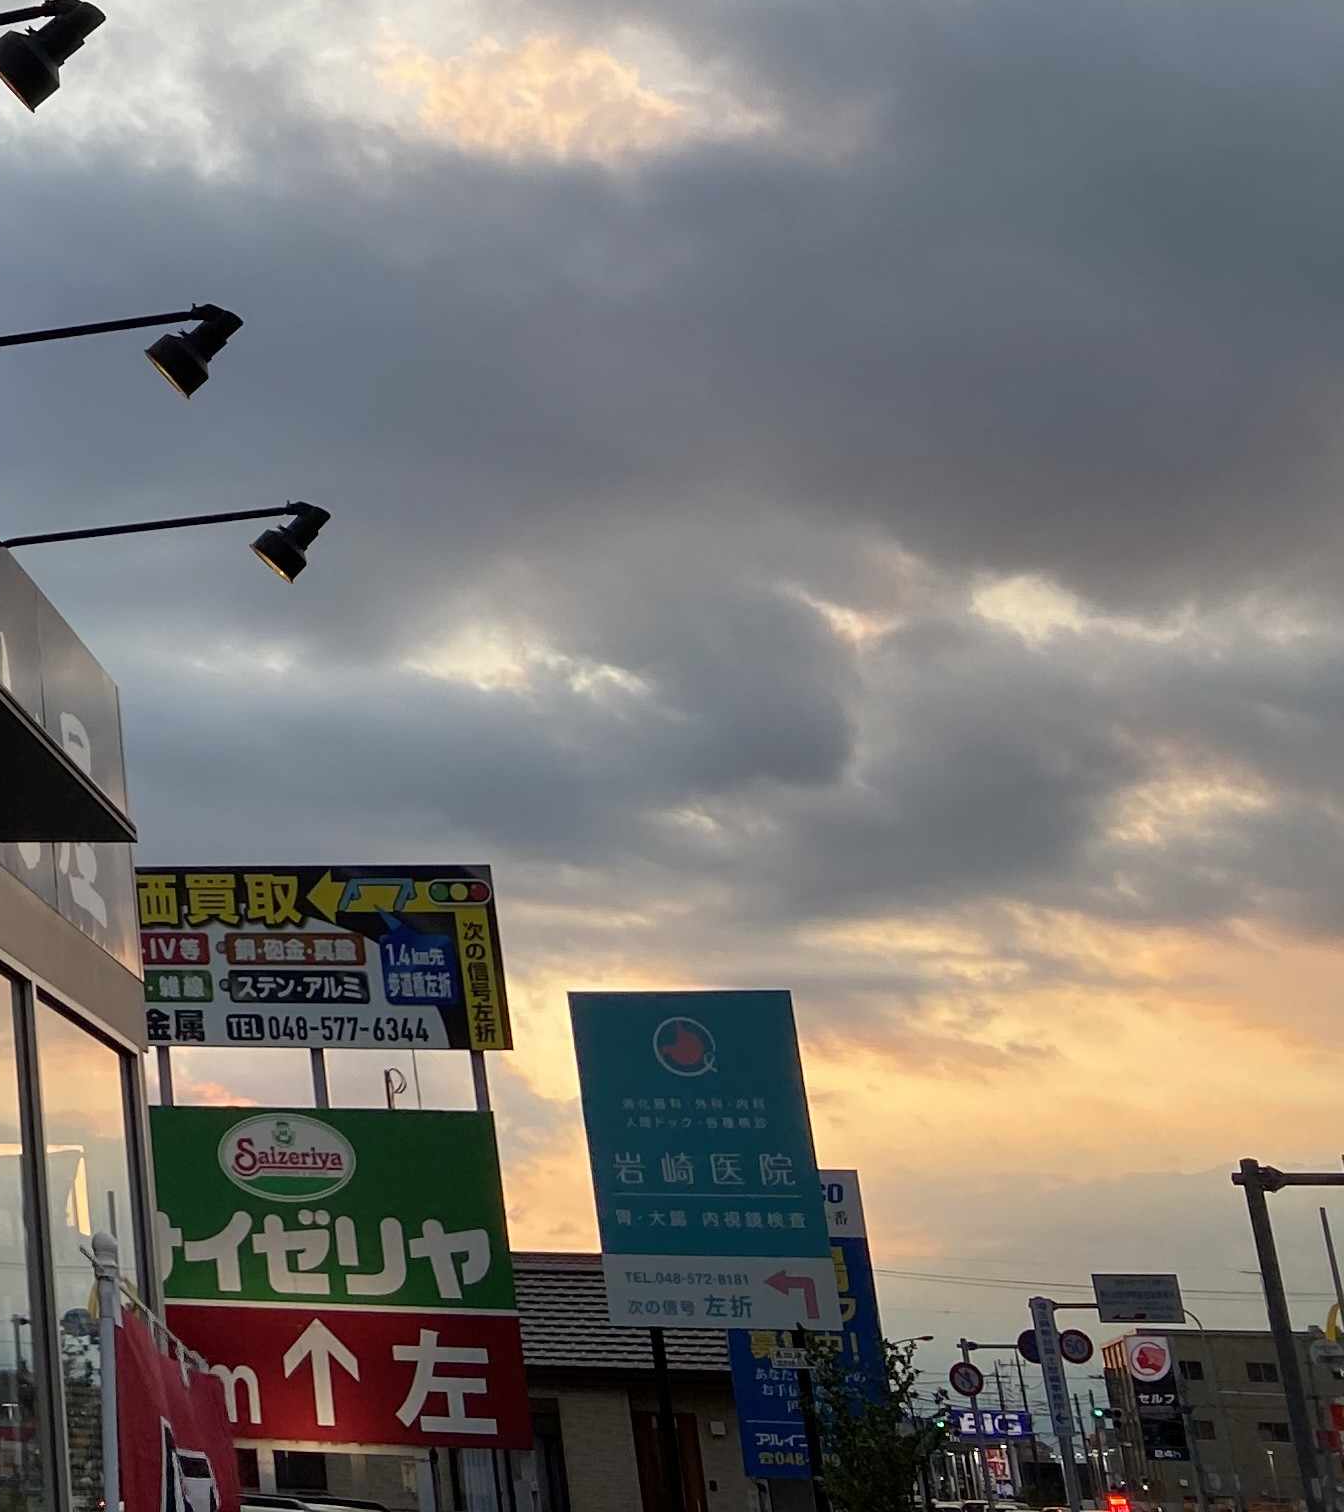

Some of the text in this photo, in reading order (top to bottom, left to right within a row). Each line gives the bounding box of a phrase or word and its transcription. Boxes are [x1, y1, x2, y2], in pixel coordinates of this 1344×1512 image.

[237, 976, 362, 999] ステン・アルミ
[463, 921, 496, 1043] 次の信号左折
[146, 1007, 206, 1042] 金属
[228, 1016, 430, 1043] TEL 048-577-6344
[234, 1137, 343, 1173] Saizeriya
[612, 1150, 796, 1187] 岩崎医院
[627, 1293, 753, 1319] 次の信号 左折
[391, 1329, 499, 1435] 左
[1138, 1392, 1175, 1405] セルフ
